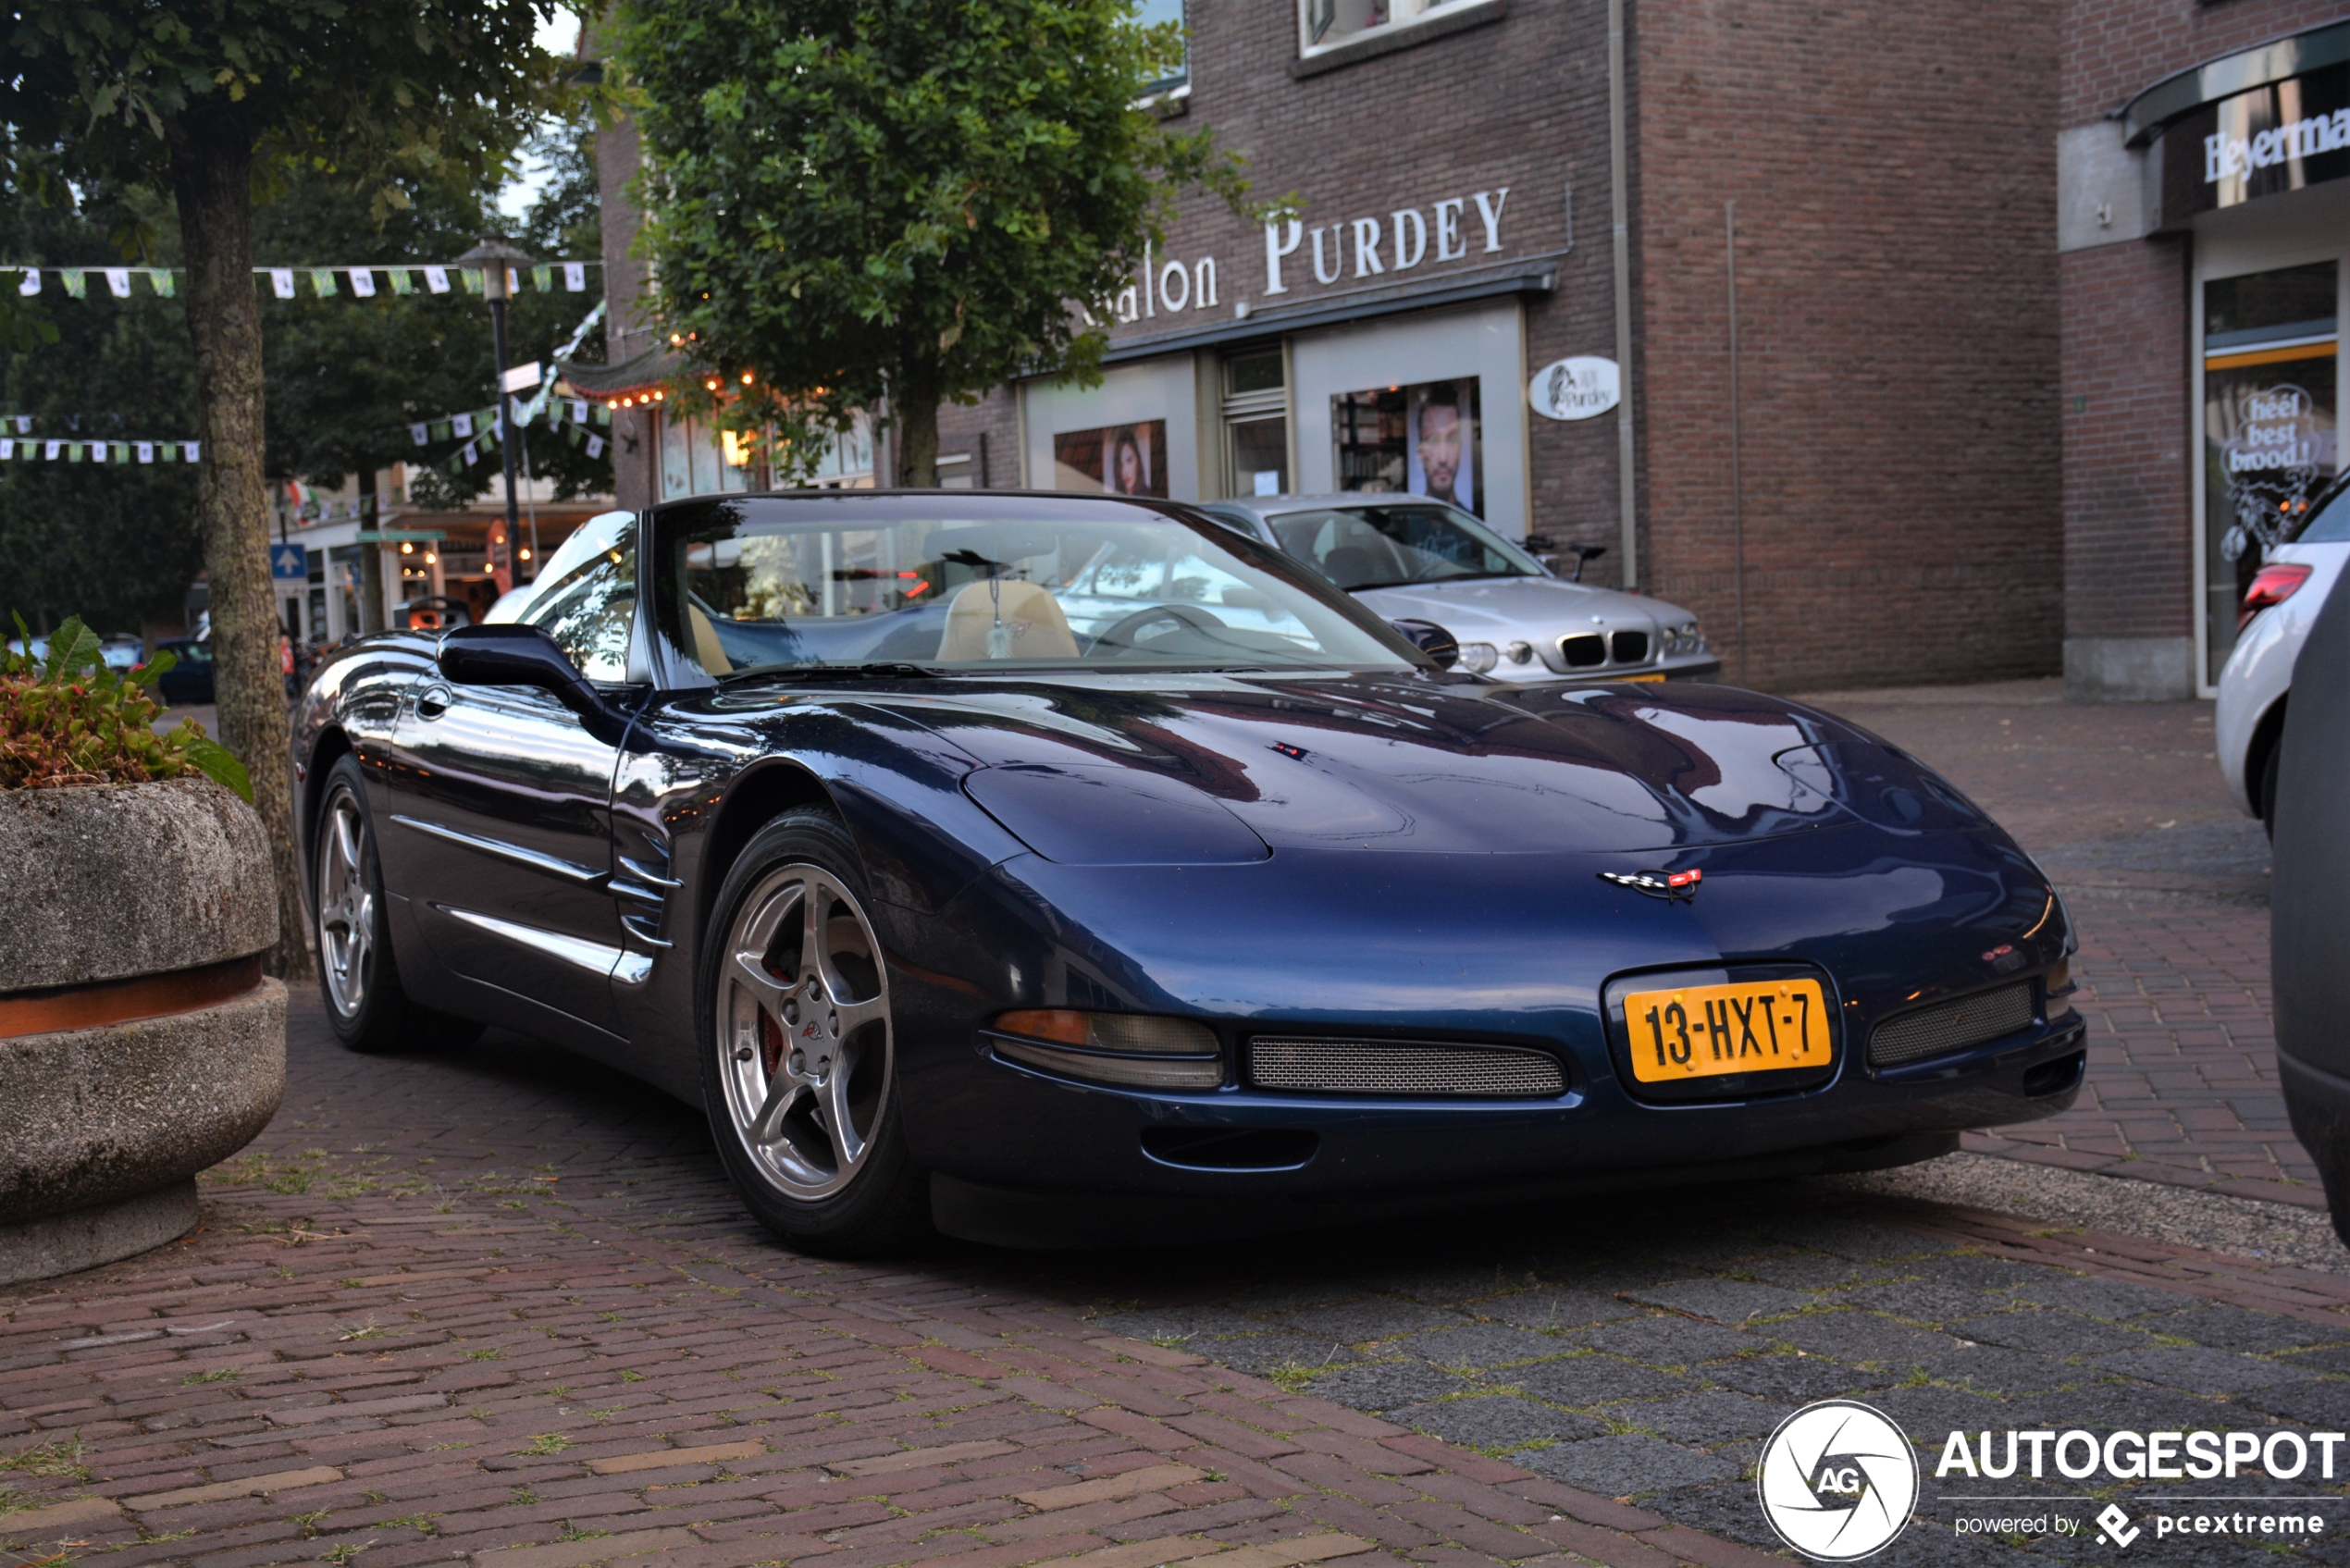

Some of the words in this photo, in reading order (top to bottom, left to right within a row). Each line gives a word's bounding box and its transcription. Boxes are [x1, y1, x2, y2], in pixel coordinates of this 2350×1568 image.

[1263, 188, 1511, 297] PURDEY
[2248, 422, 2297, 447] best
[1645, 993, 1810, 1066] 13-HXT-7
